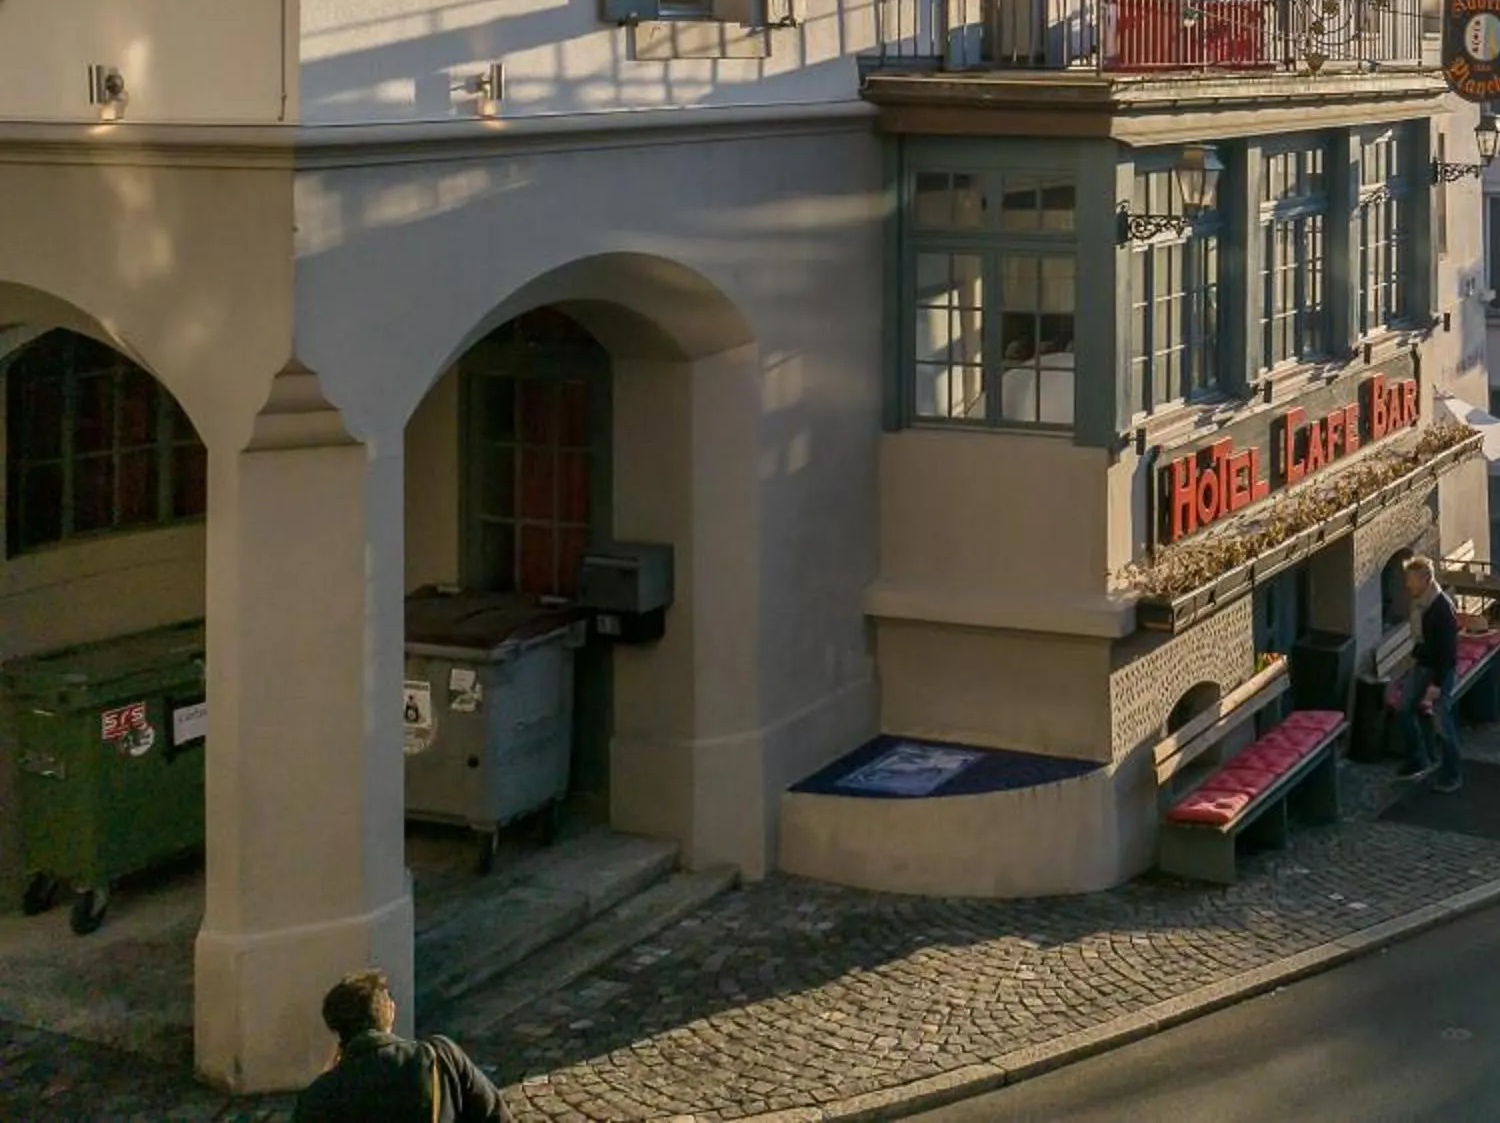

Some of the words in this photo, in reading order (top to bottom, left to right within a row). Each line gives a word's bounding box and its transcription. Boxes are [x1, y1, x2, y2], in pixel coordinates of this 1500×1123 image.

[1172, 436, 1270, 542] HOTEL
[1285, 402, 1360, 488] CAFE
[1371, 372, 1418, 441] BAR
